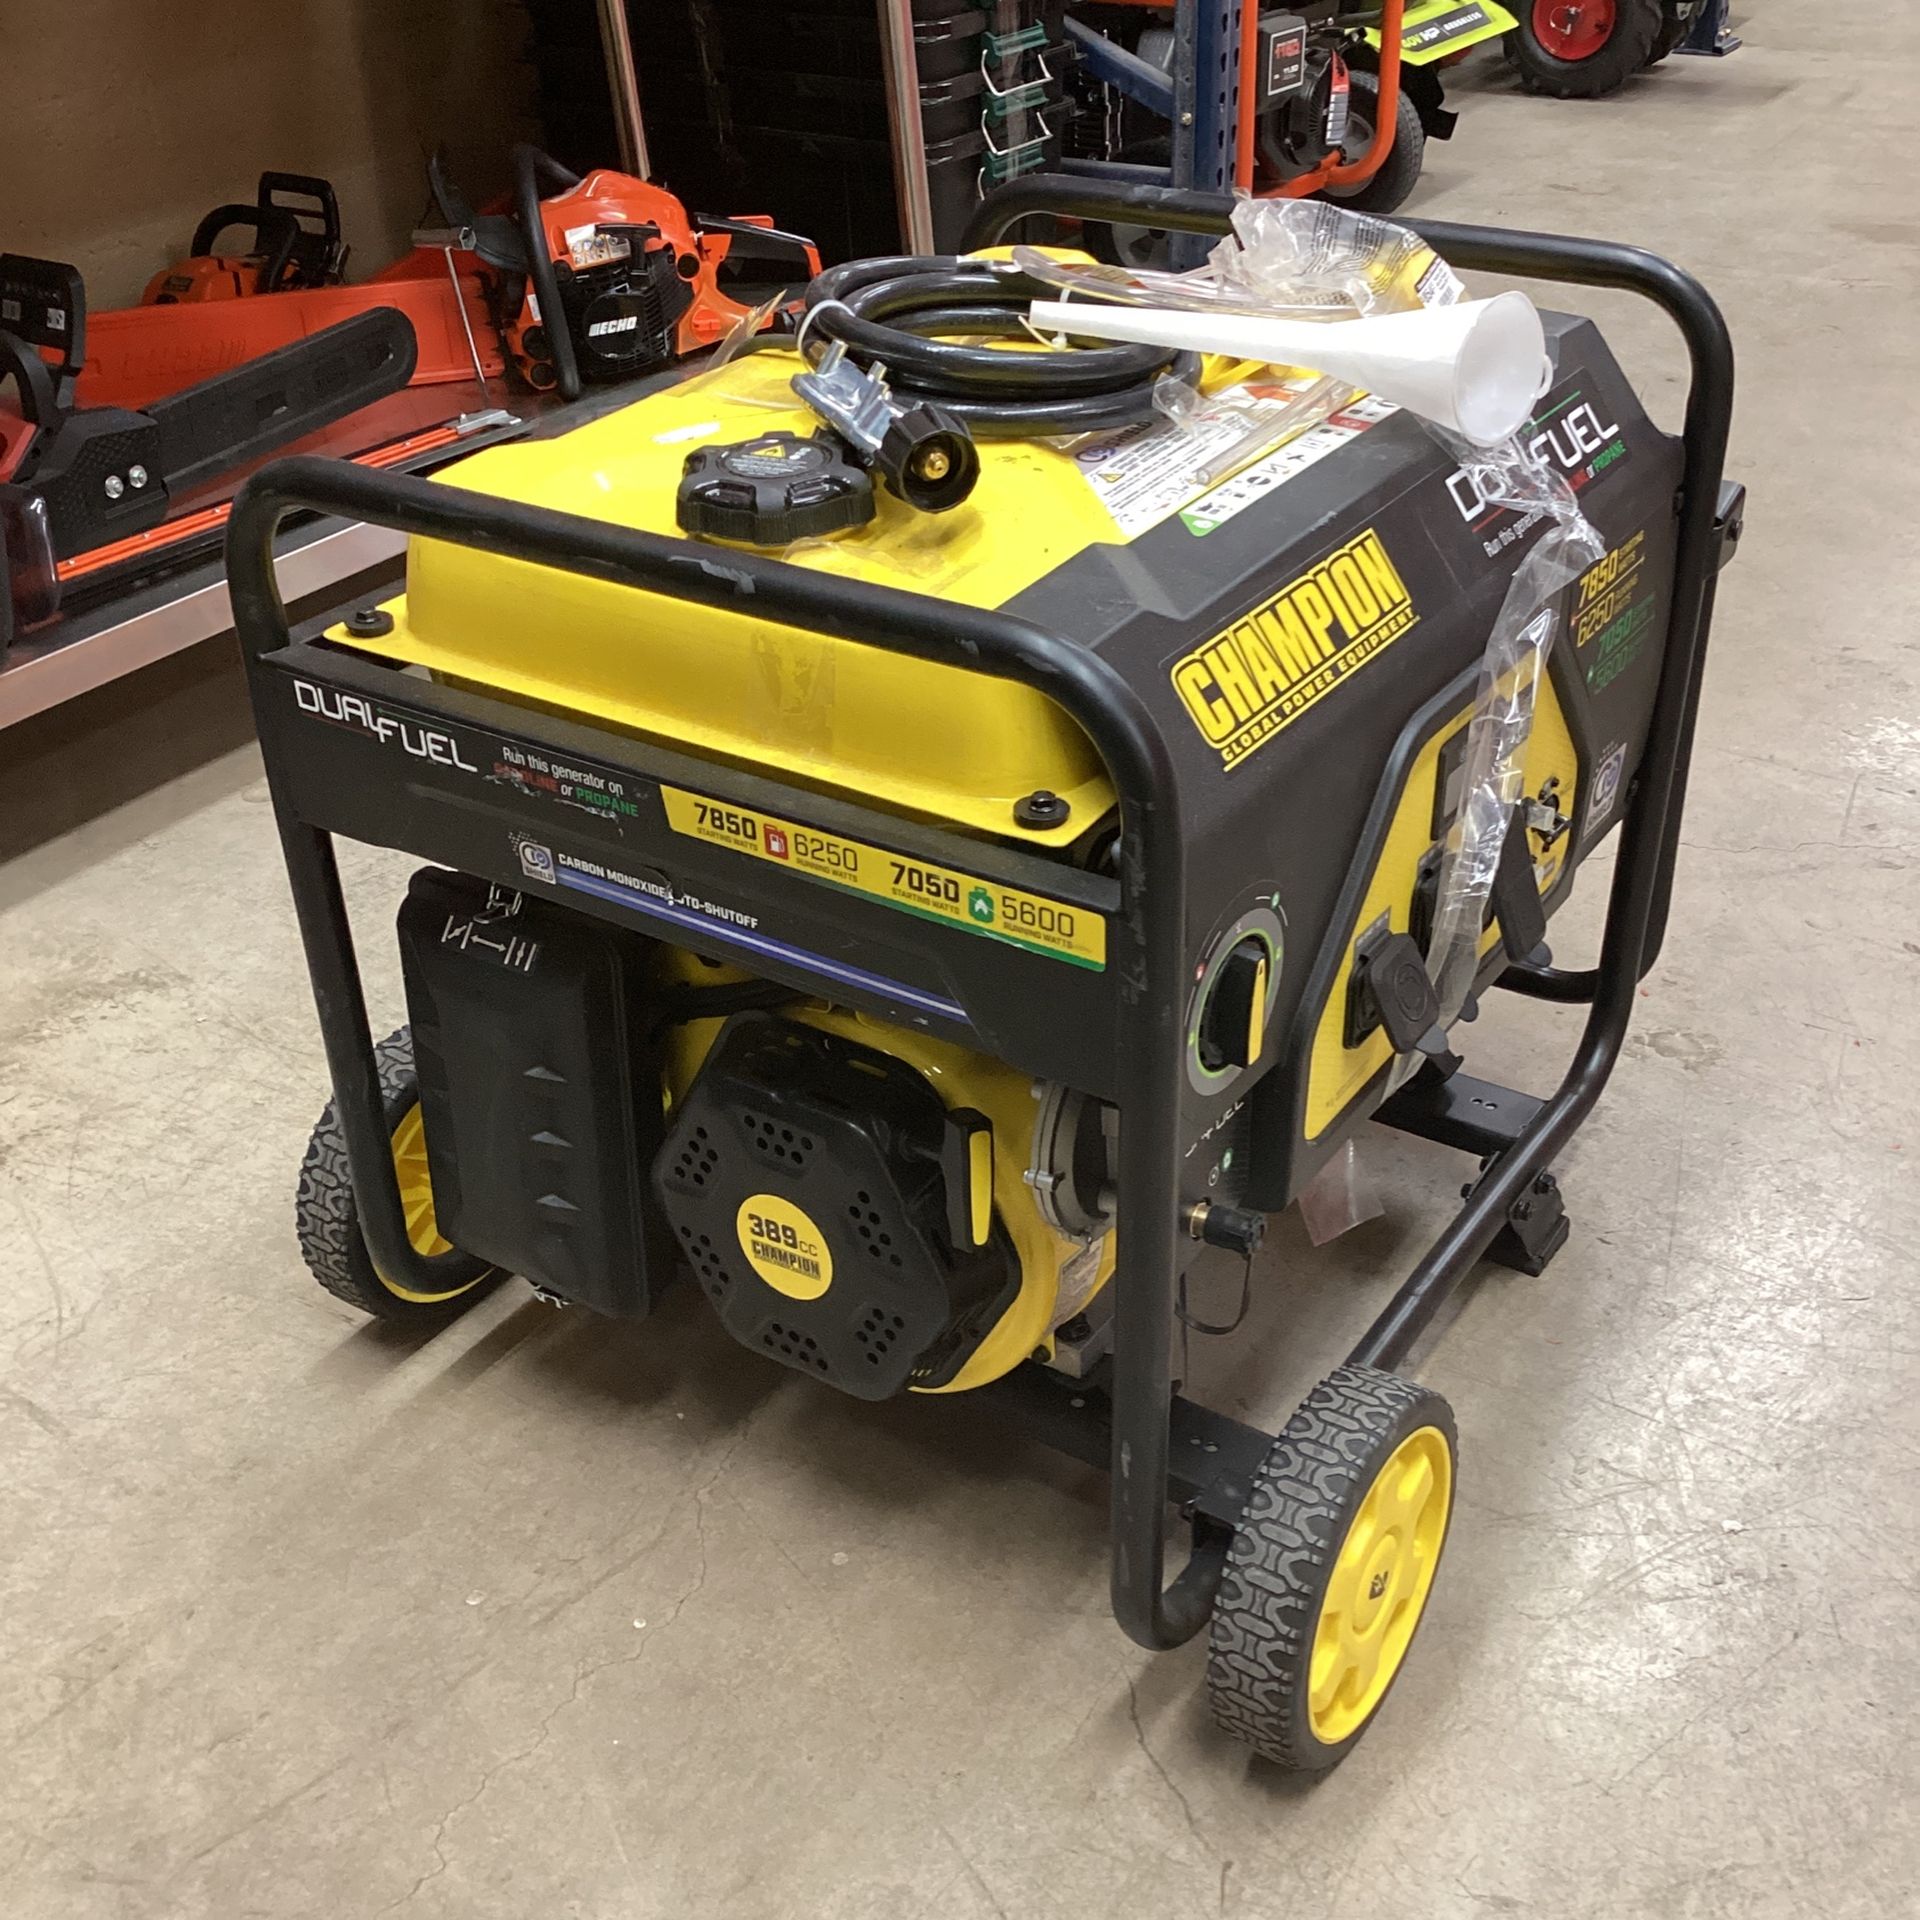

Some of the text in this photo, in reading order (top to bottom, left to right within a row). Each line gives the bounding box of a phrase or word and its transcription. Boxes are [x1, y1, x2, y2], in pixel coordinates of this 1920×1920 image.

[599, 316, 637, 336] ECHO
[1579, 548, 1619, 609] 7850
[1173, 532, 1409, 746] CHAMPION
[1577, 592, 1615, 649] 6250
[1221, 608, 1414, 762] GLOBAL POWER EQUIPMENT
[502, 746, 624, 797] Run this generator on
[561, 784, 573, 797] or
[575, 787, 640, 818] PROPANE
[558, 853, 605, 879] CARBON
[606, 870, 666, 898] MONOXIDE
[694, 802, 1075, 938] 7850 6250 7050 5600
[891, 887, 931, 907] STARTING
[932, 900, 960, 915] WATTS
[751, 1239, 821, 1279] CHAMPION
